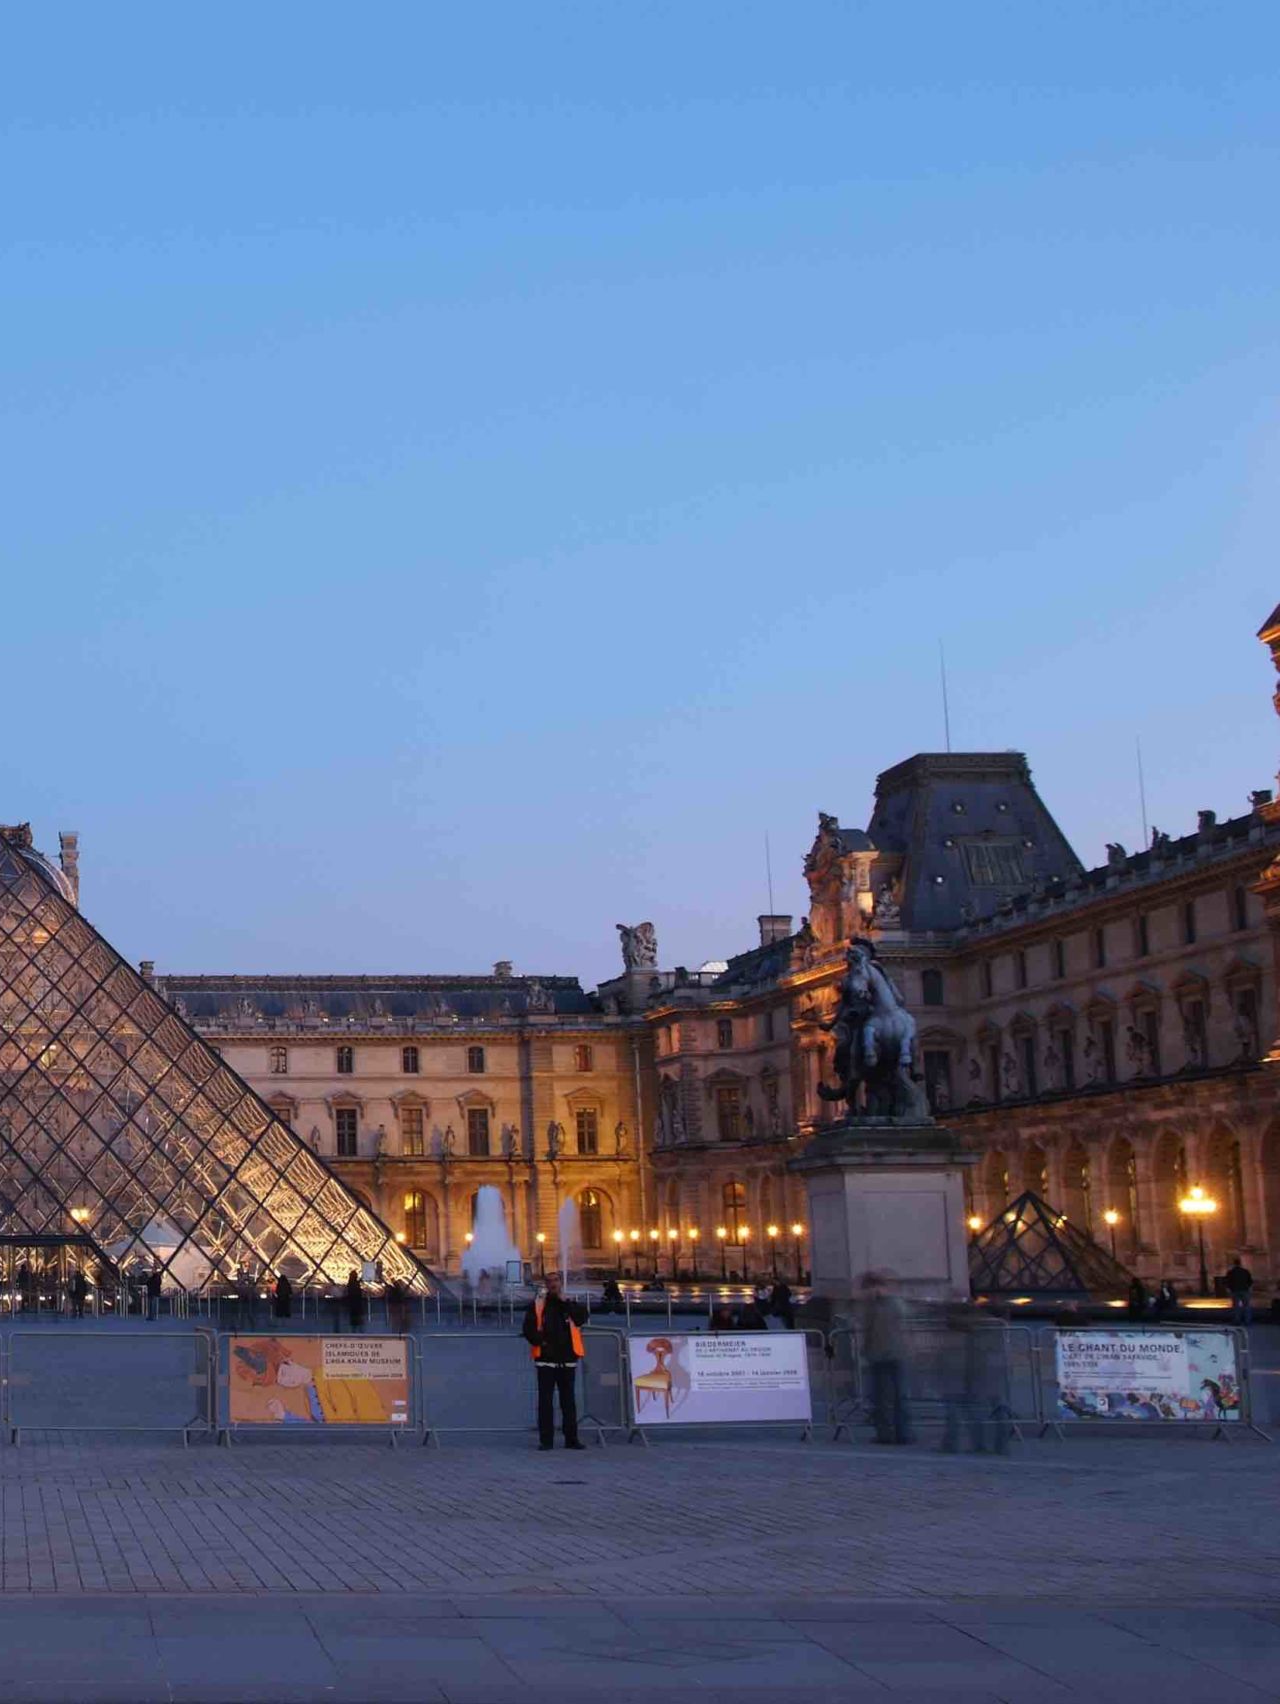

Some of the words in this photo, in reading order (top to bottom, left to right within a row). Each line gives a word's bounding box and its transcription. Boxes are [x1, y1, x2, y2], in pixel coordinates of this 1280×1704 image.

[1062, 1343, 1074, 1352] LE
[1078, 1343, 1116, 1352] CHANT
[1120, 1343, 1135, 1352] DU
